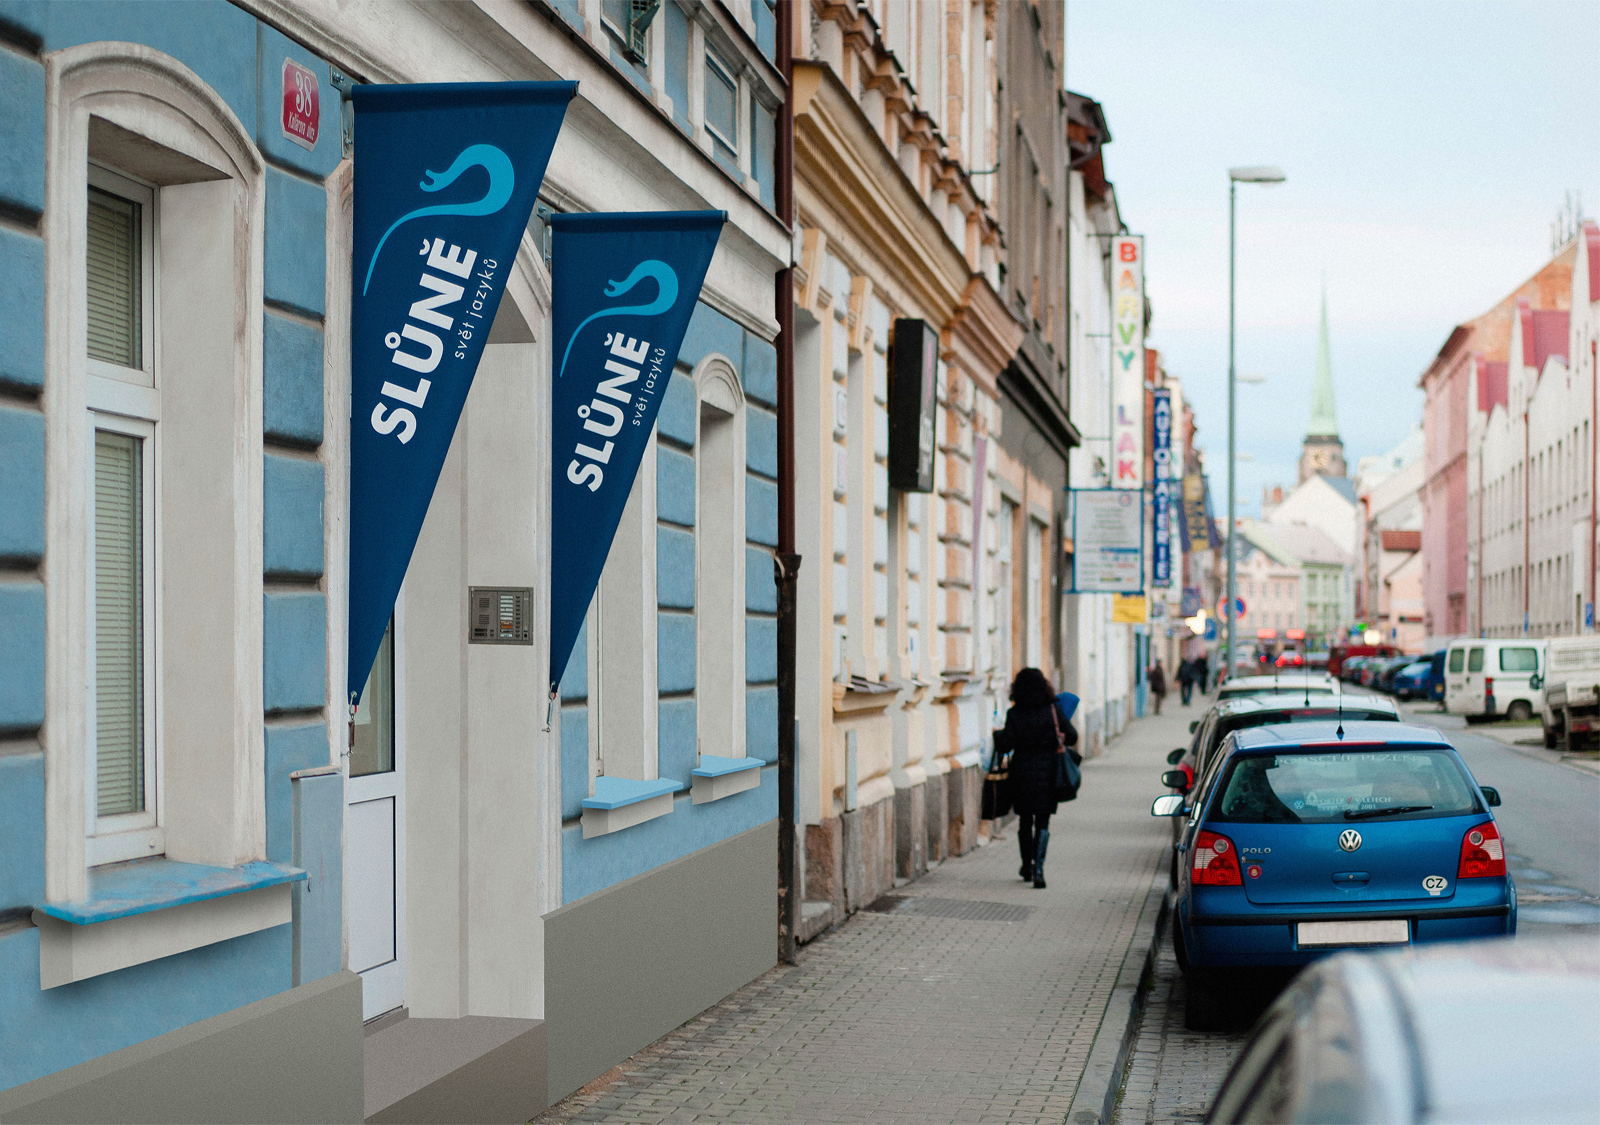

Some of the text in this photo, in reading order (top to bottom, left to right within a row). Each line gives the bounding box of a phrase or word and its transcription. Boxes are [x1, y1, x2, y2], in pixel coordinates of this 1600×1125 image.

[296, 71, 312, 117] 38
[371, 238, 478, 445] SLŮNĚ
[455, 258, 498, 360] svět jazyků
[1118, 242, 1137, 489] BARVY LAK
[567, 332, 650, 493] SLŮNĚ
[632, 348, 666, 427] svět jazyků
[1154, 400, 1171, 578] AUTOBATERIE
[1425, 878, 1444, 889] CZ
